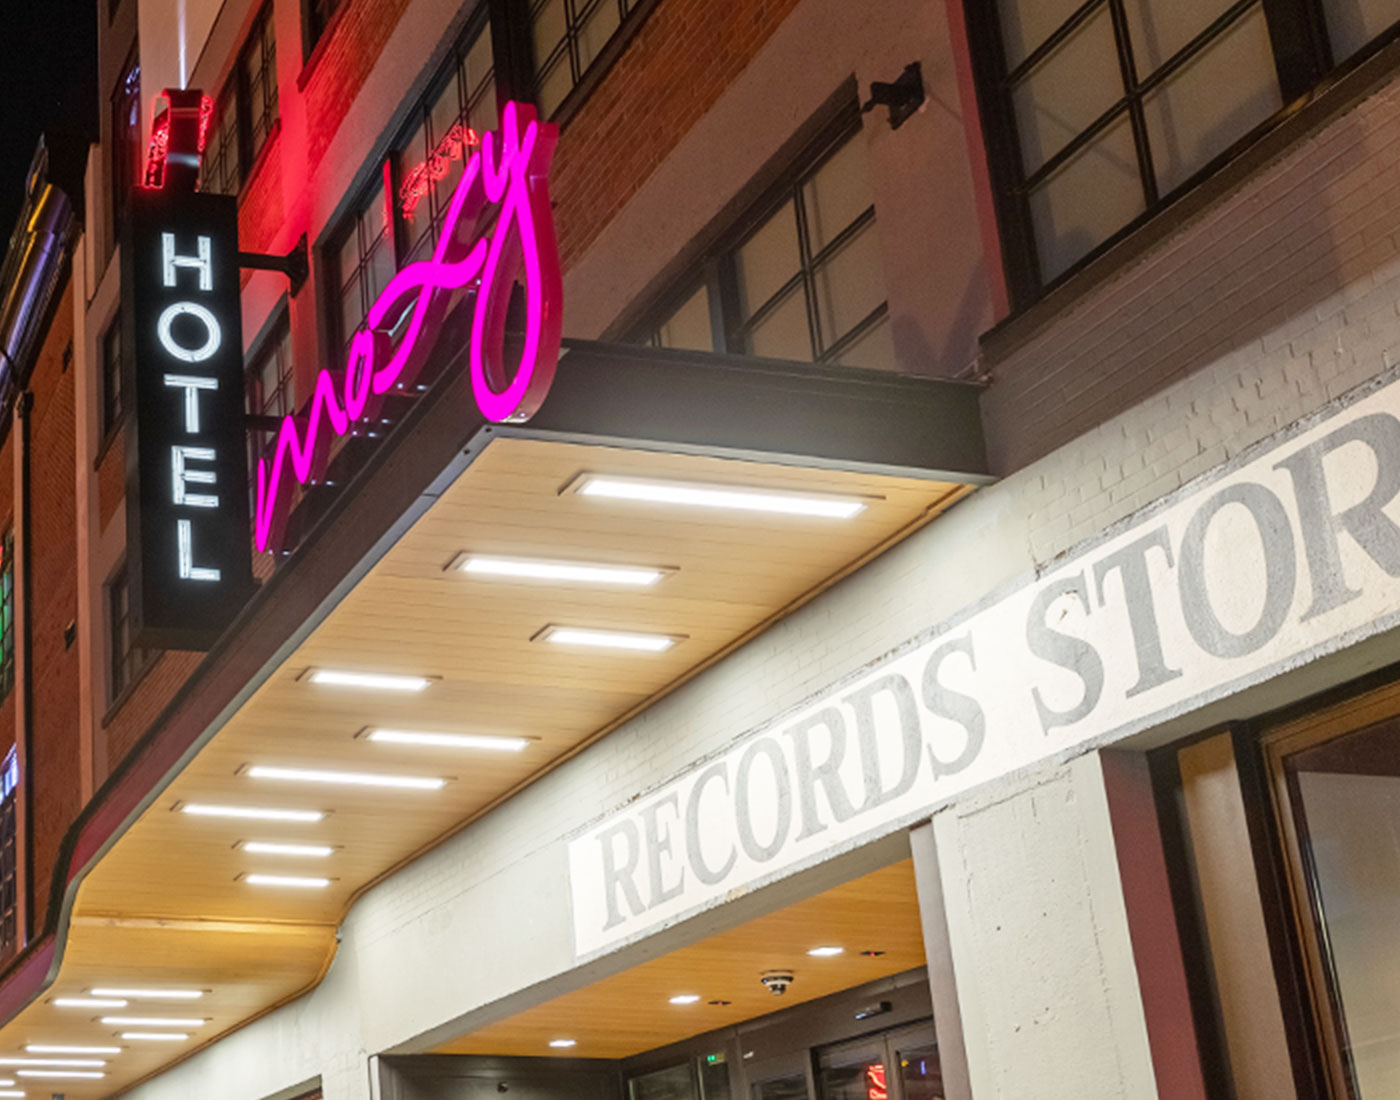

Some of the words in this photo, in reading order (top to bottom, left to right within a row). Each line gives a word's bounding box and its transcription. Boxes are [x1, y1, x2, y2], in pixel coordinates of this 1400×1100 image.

[157, 231, 222, 582] HOTEL
[256, 101, 542, 553] moxy
[594, 629, 988, 933] RECORDS
[1025, 411, 1400, 738] STOR
